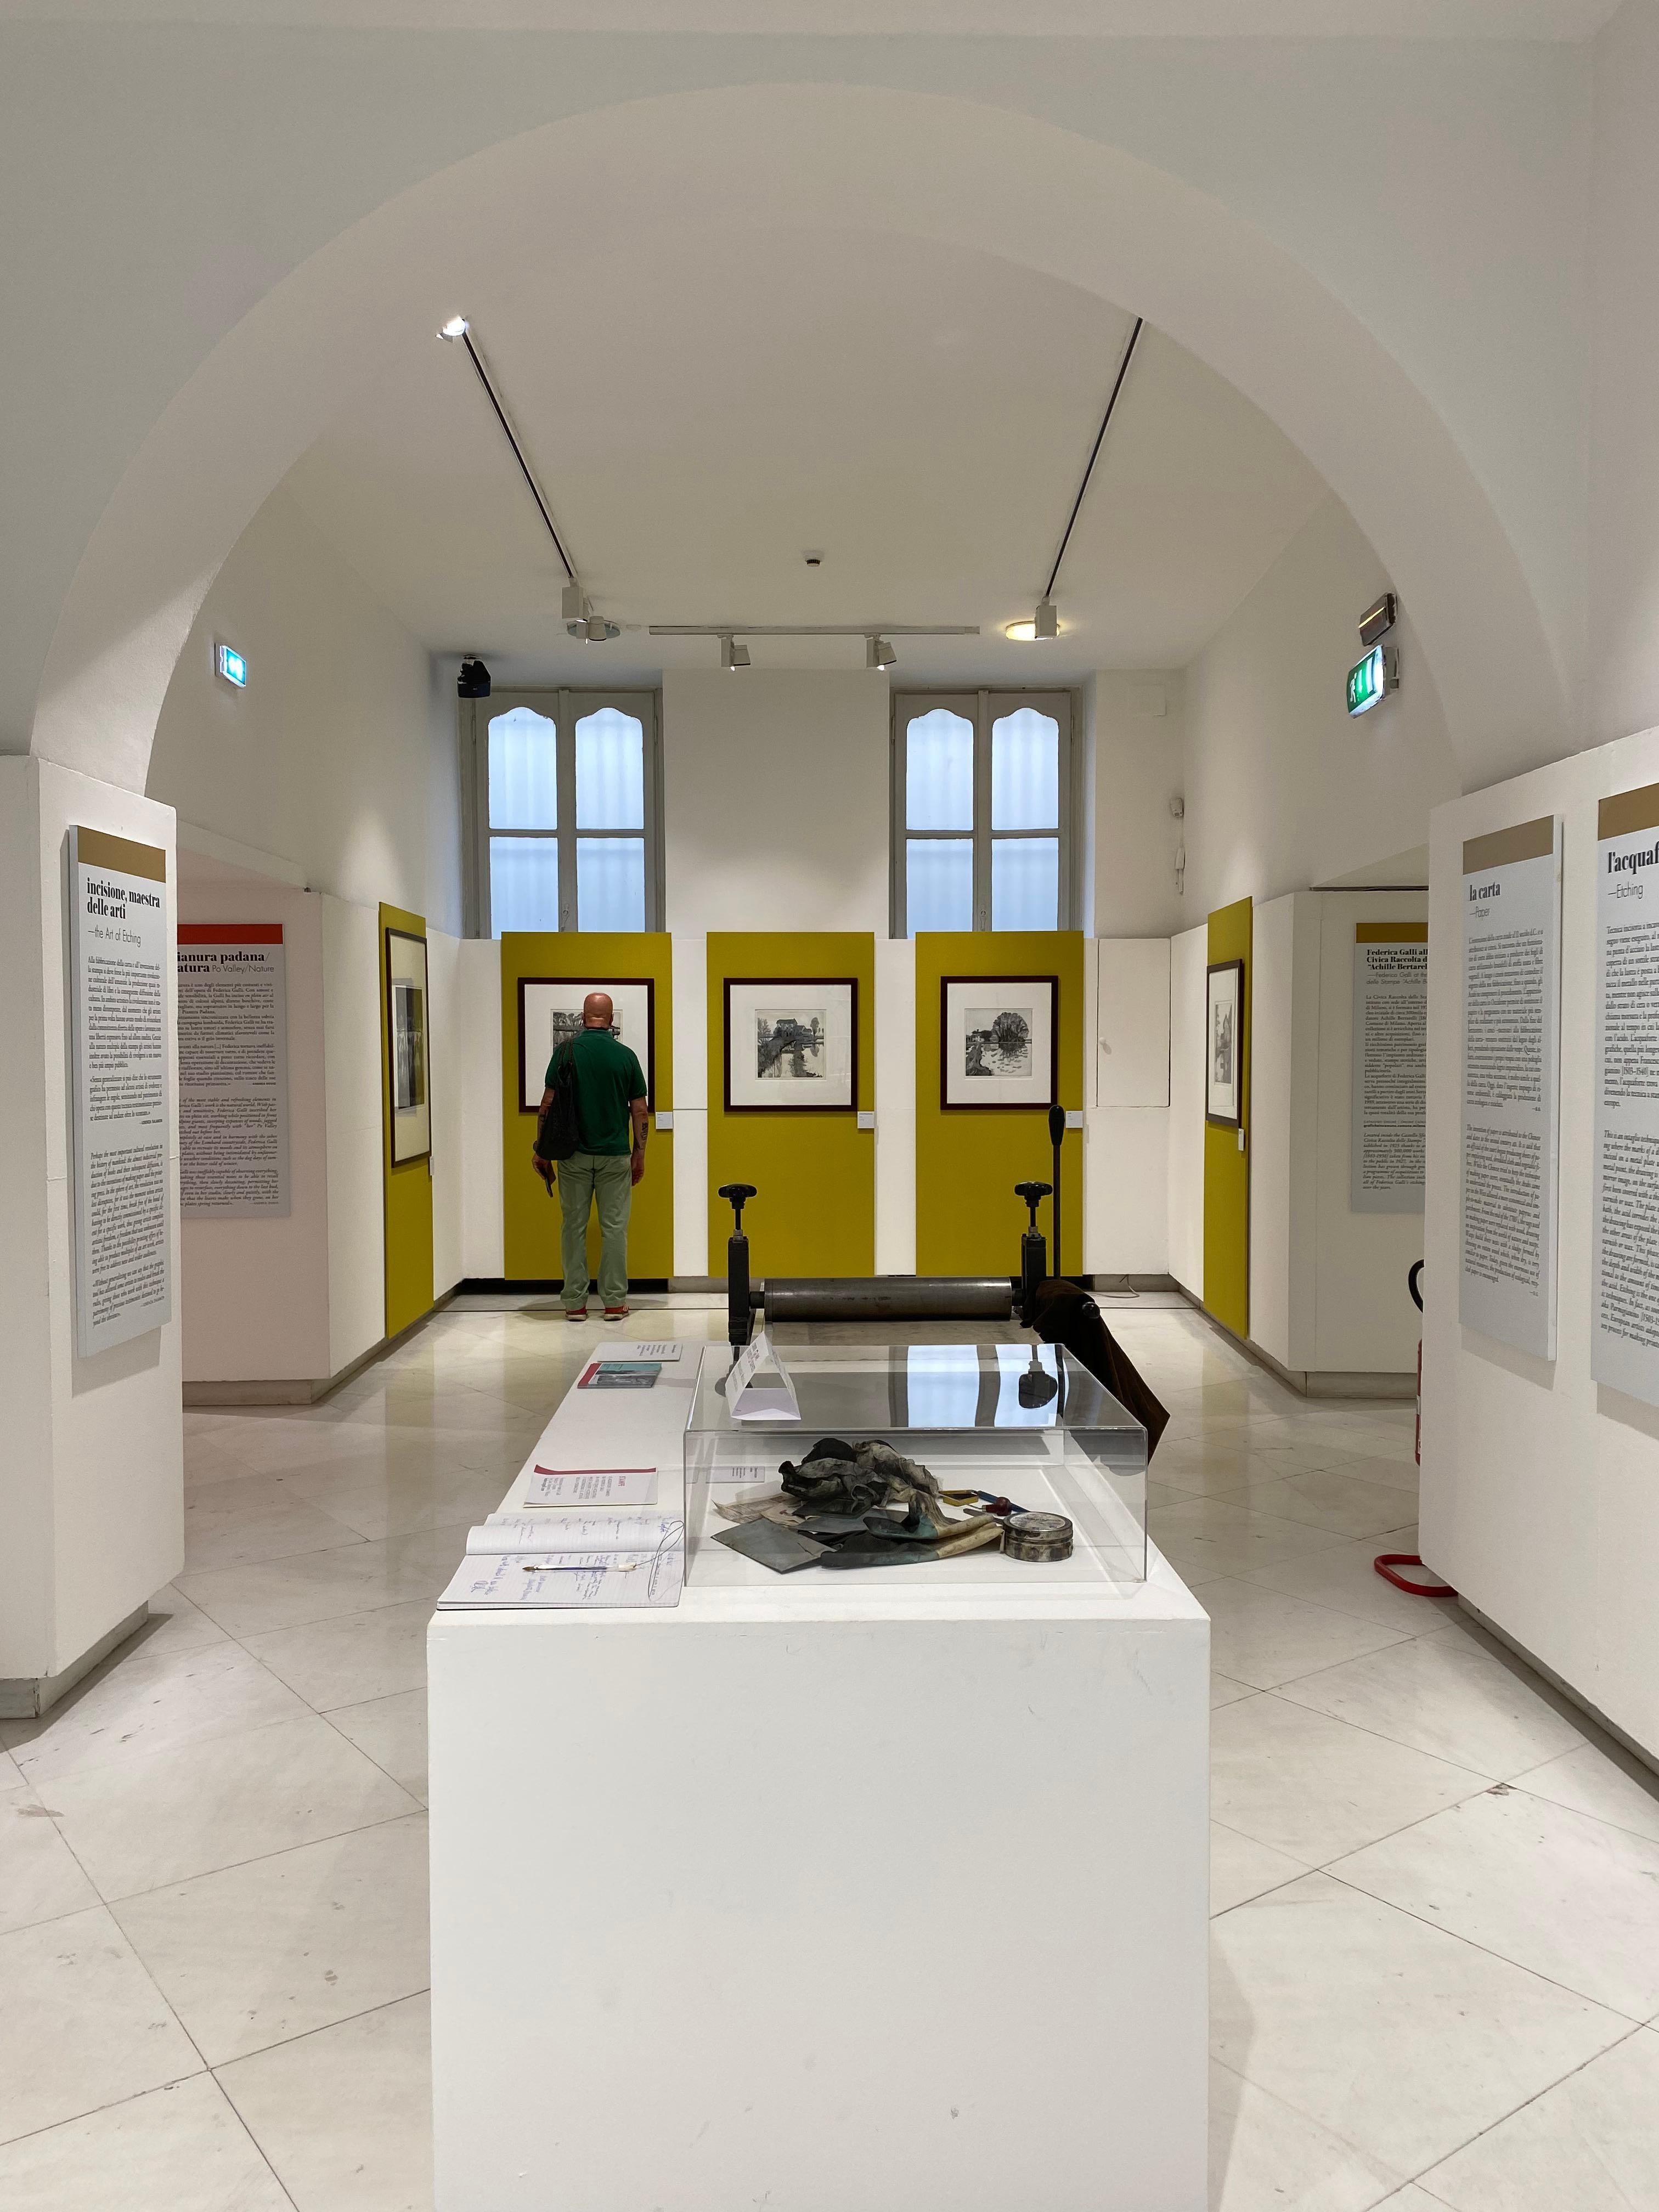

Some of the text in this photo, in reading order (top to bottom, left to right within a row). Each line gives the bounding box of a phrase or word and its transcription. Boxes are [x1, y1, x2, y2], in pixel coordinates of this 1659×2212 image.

[1608, 840, 1659, 874] l'acquaf
[87, 877, 160, 908] incisione, maestra
[1470, 882, 1500, 901] la carta
[88, 896, 126, 919] delle arti
[105, 927, 114, 939] Art
[115, 928, 121, 941] of
[122, 929, 141, 947] Etching
[177, 952, 217, 962] ianura
[177, 964, 210, 973] atura
